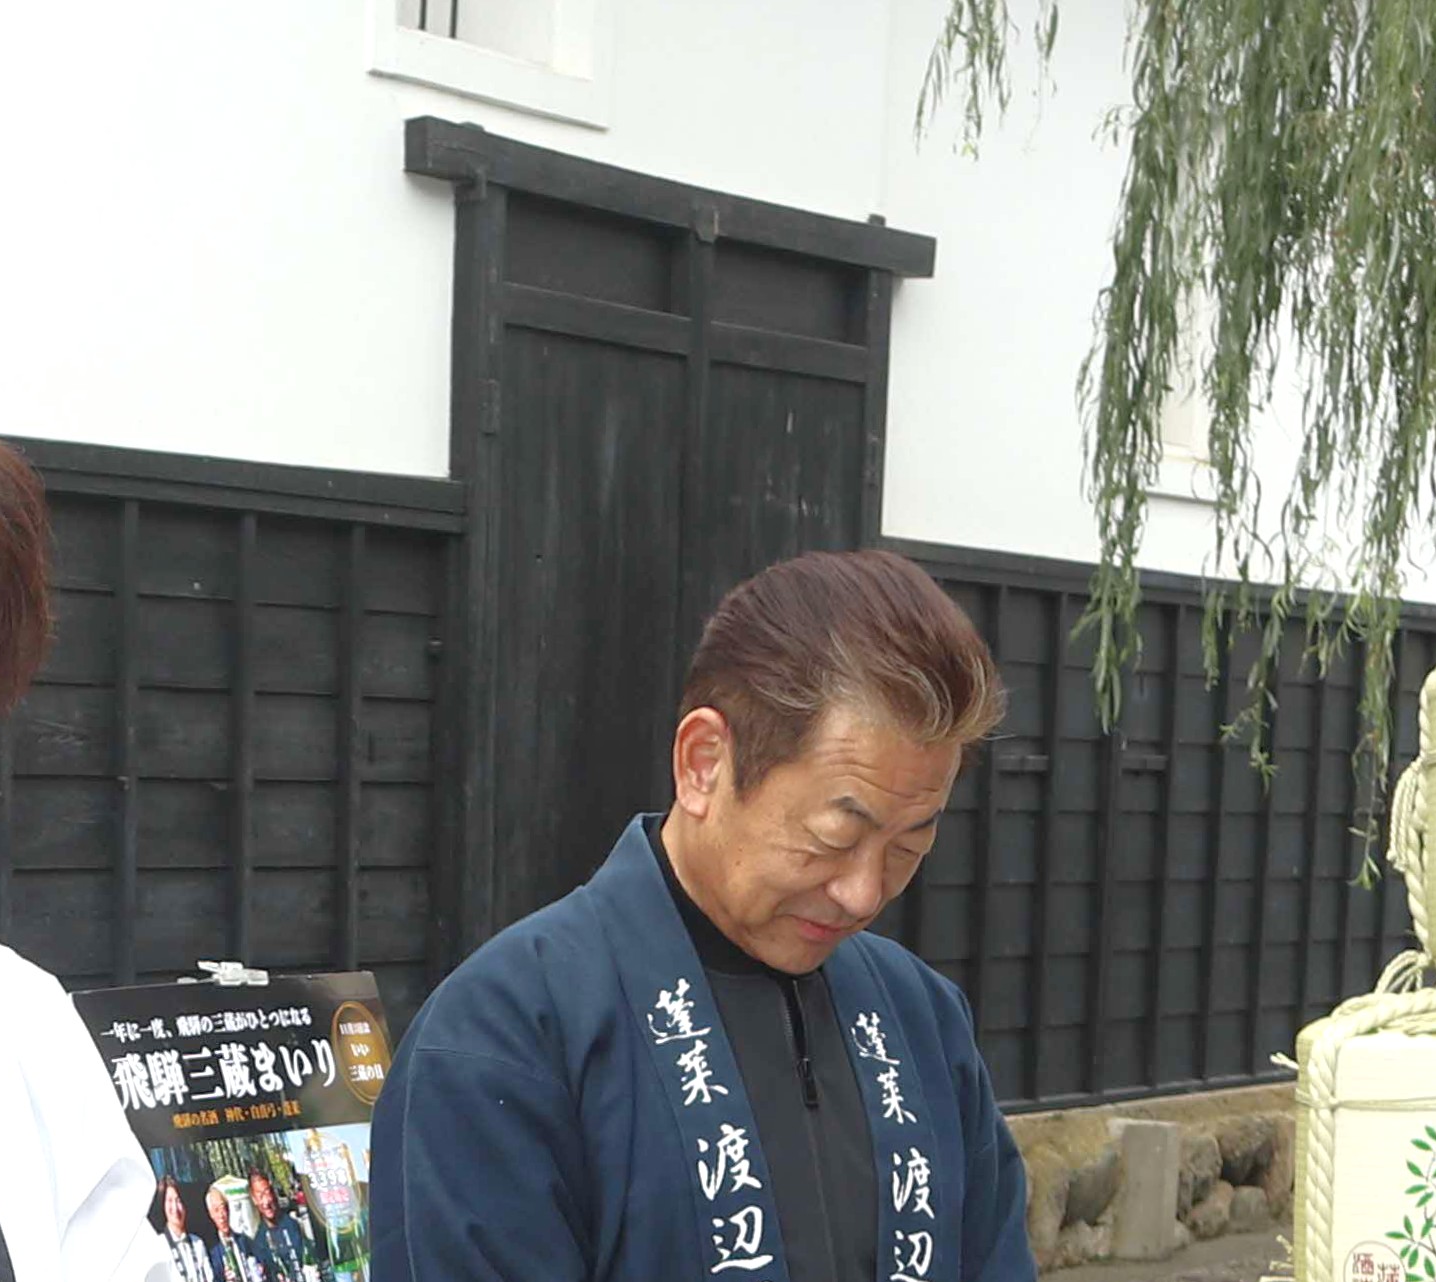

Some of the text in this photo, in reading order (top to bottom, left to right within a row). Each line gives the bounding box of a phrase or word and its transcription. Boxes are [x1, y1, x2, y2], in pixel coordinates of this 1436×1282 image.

[111, 1039, 336, 1111] 飛騨三蔵まいり
[647, 978, 728, 1107] 蓬莱
[851, 1012, 918, 1126] 蓬莱
